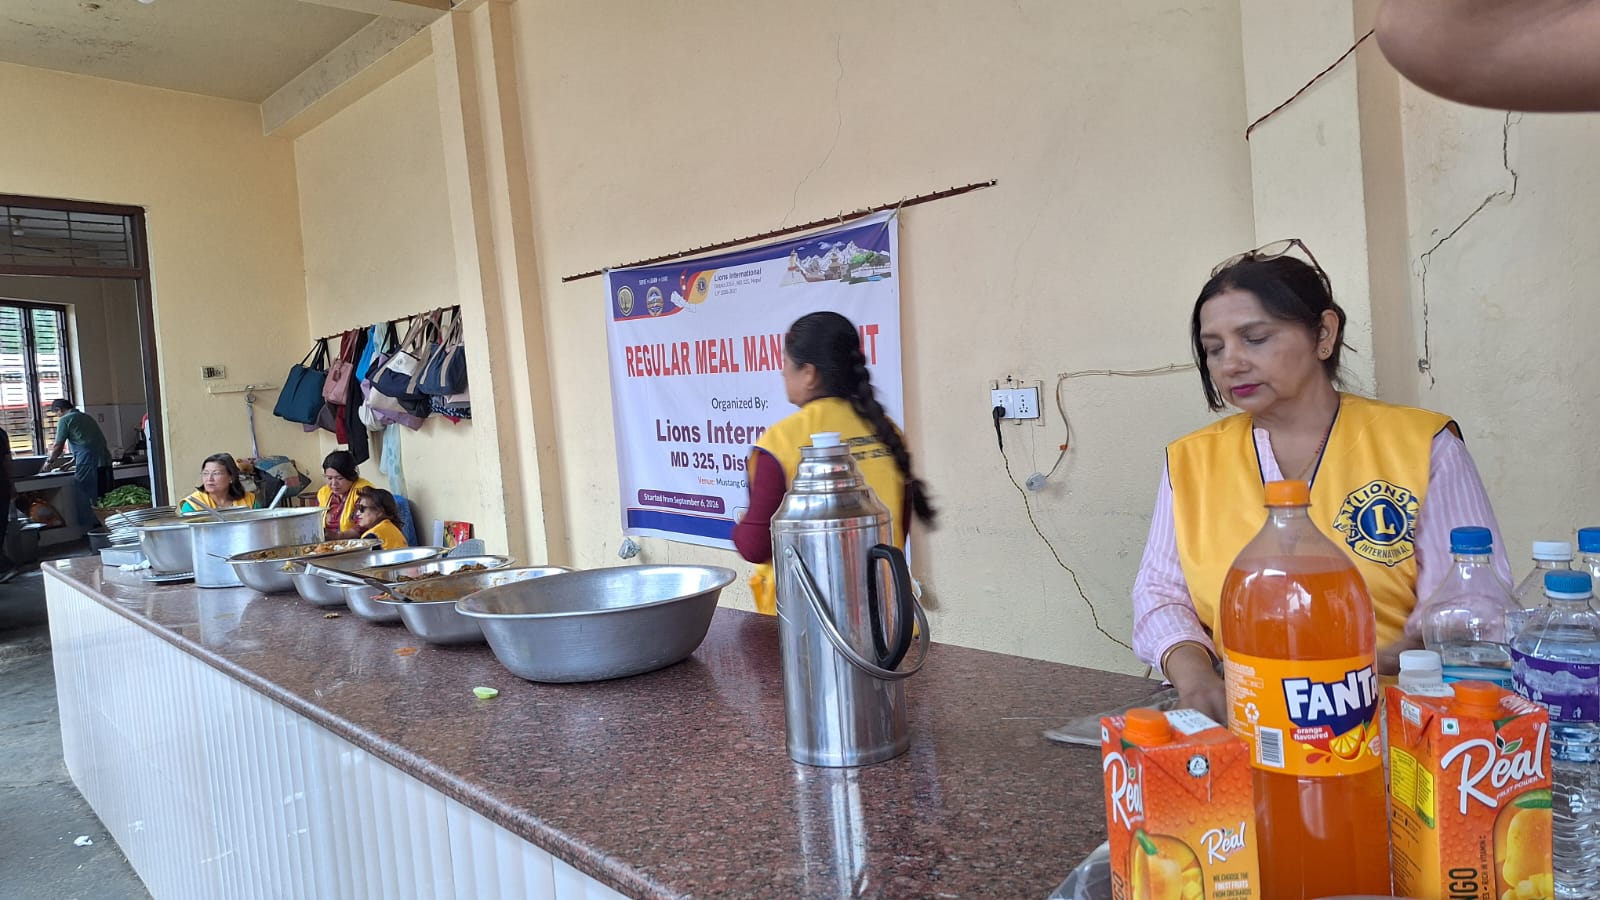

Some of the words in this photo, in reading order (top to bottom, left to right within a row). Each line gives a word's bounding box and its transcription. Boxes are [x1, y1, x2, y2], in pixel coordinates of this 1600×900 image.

[714, 271, 728, 281] Lions
[729, 267, 762, 279] International
[626, 341, 691, 377] REGULAR
[695, 338, 739, 374] MEAL
[711, 397, 753, 411] Organized
[755, 396, 769, 411] By:
[656, 419, 701, 443] Lions
[707, 419, 766, 444] Intern
[671, 451, 689, 467] MD
[692, 452, 719, 473] 325,
[643, 493, 662, 502] Started
[663, 494, 673, 503] from
[673, 496, 700, 508] September
[1353, 483, 1406, 504] LIONS
[1372, 504, 1396, 535] L
[1293, 731, 1329, 741] flavoured
[1296, 727, 1323, 735] orange
[1440, 722, 1547, 815] Real
[1103, 752, 1144, 830] Real
[1200, 821, 1246, 865] Real
